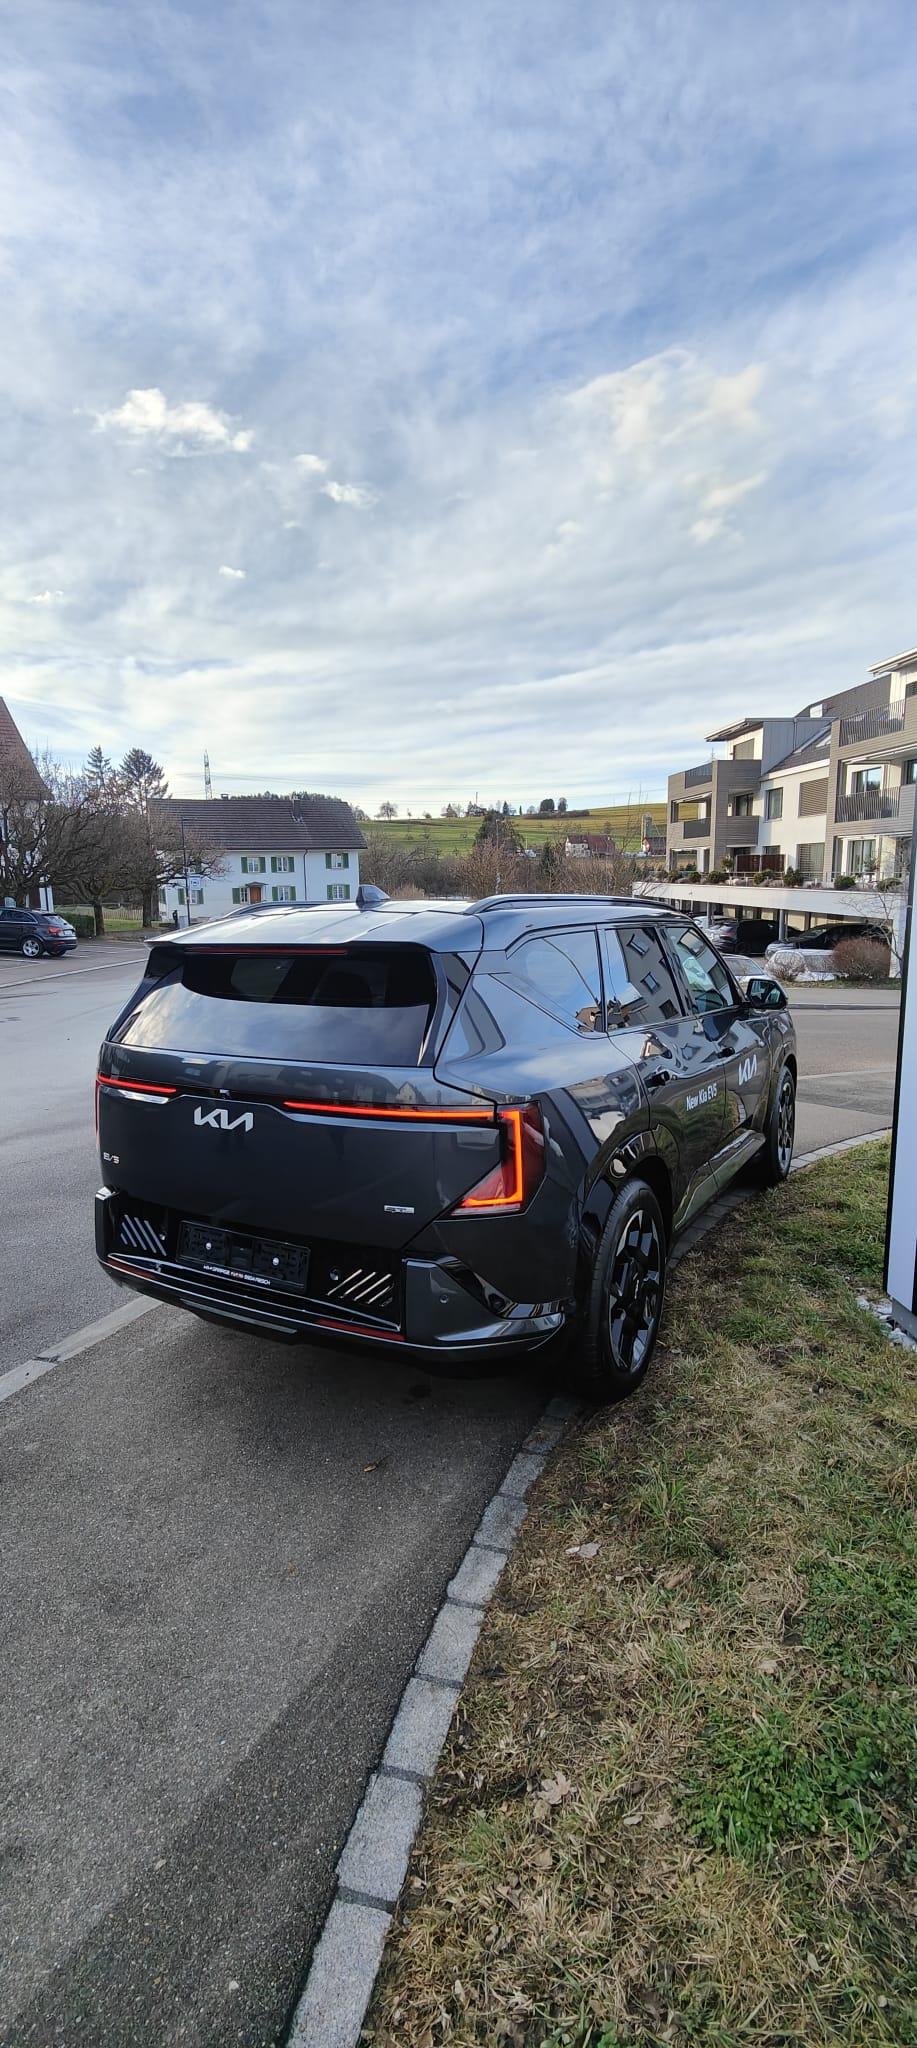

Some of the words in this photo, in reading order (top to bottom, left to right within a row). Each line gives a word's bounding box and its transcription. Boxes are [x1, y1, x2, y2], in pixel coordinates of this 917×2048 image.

[686, 1095, 699, 1111] New
[699, 1088, 707, 1104] Kia
[194, 1106, 254, 1132] KIA
